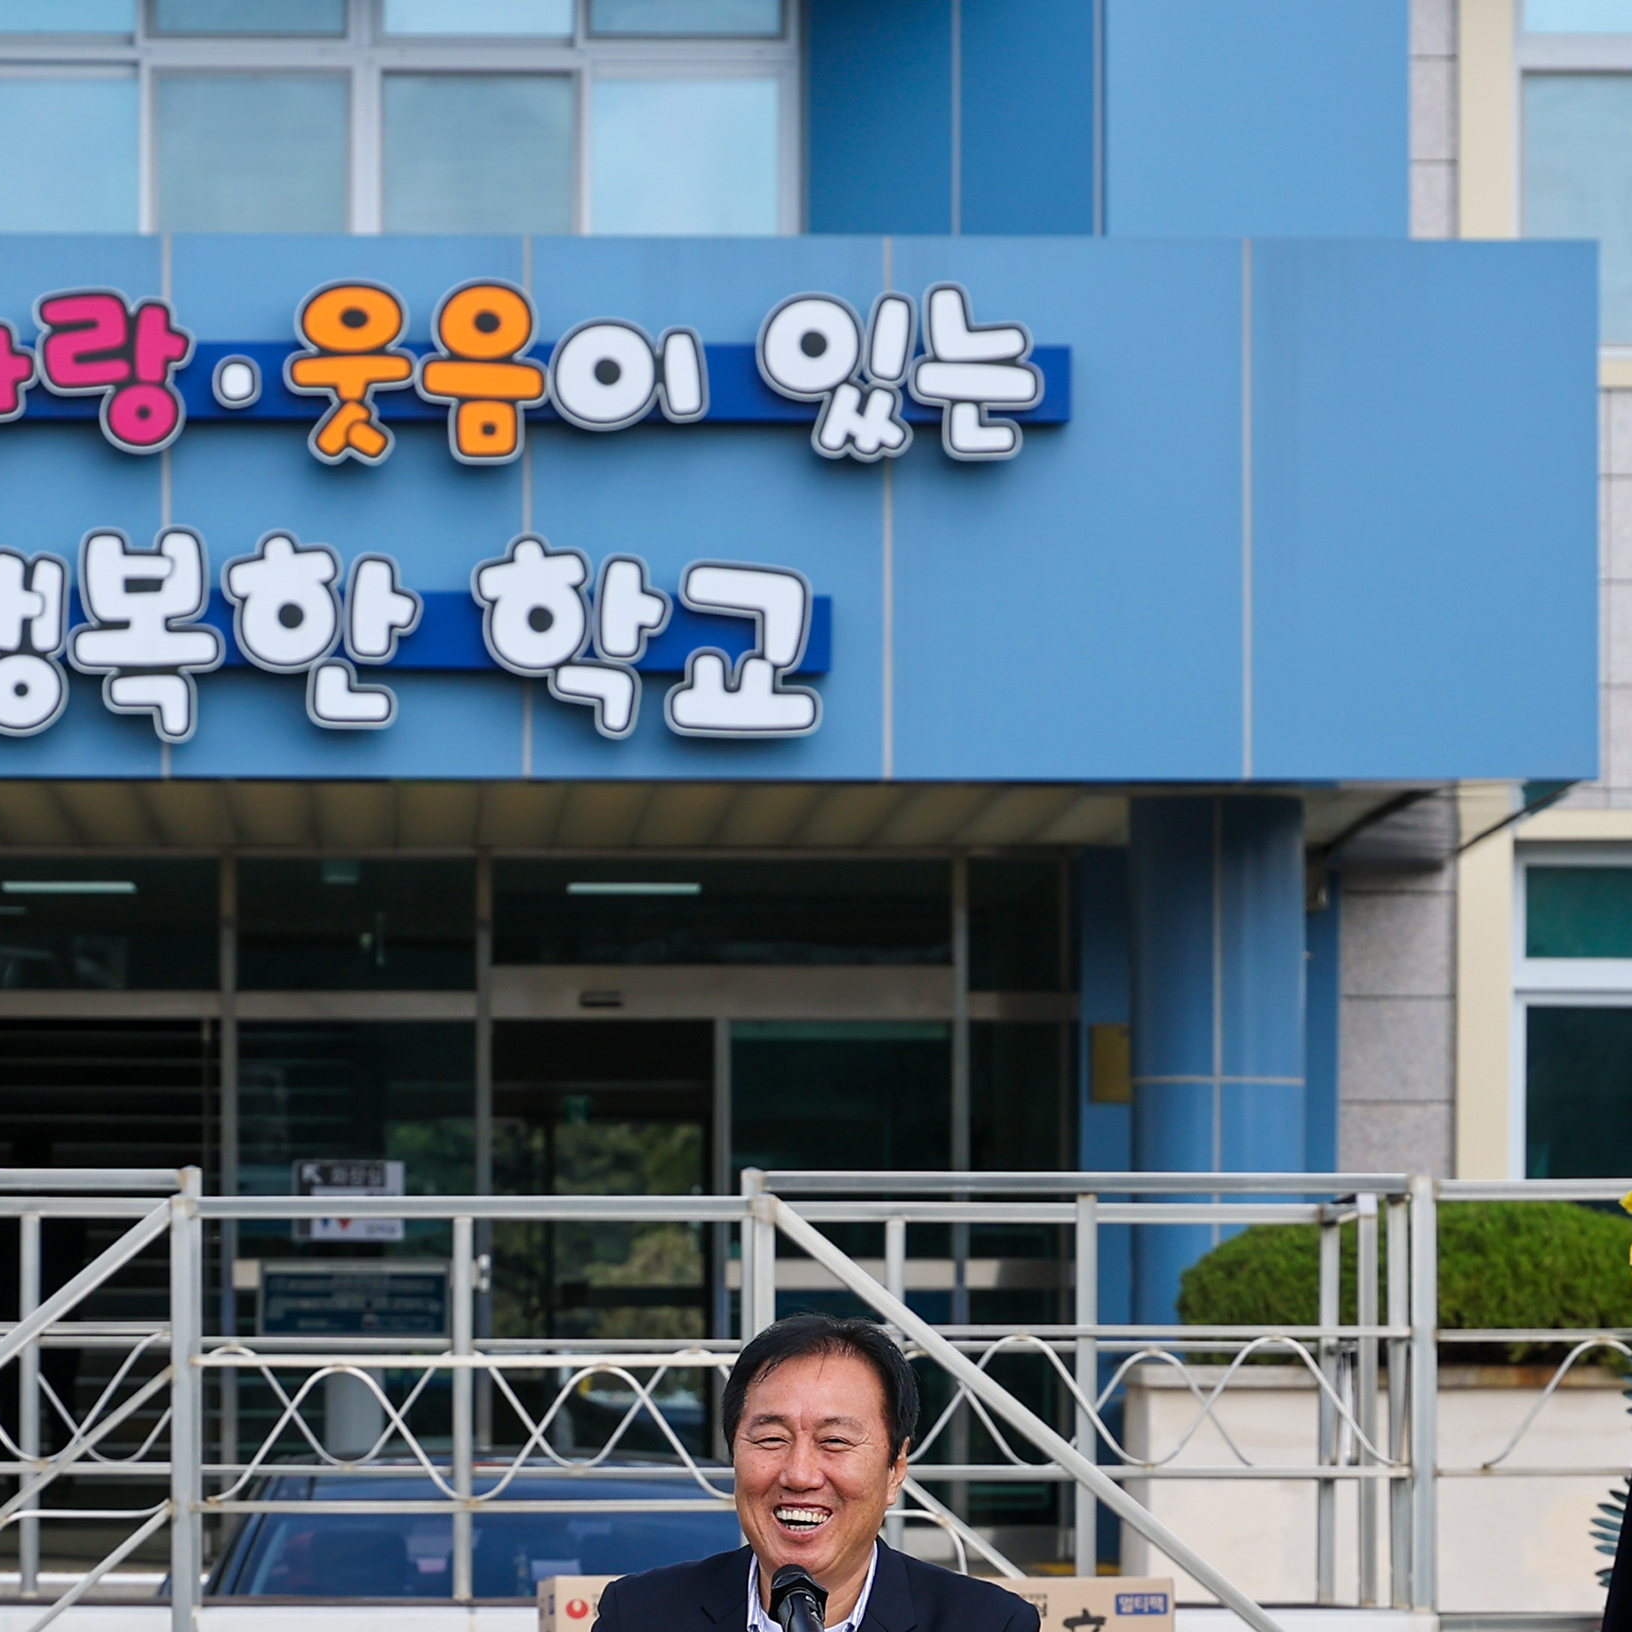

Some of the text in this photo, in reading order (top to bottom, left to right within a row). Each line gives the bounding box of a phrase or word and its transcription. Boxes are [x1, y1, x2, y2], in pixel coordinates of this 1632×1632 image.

[755, 281, 1042, 464] 있는
[472, 533, 823, 740] 학교
[1117, 1594, 1166, 1614] 멀티팩
